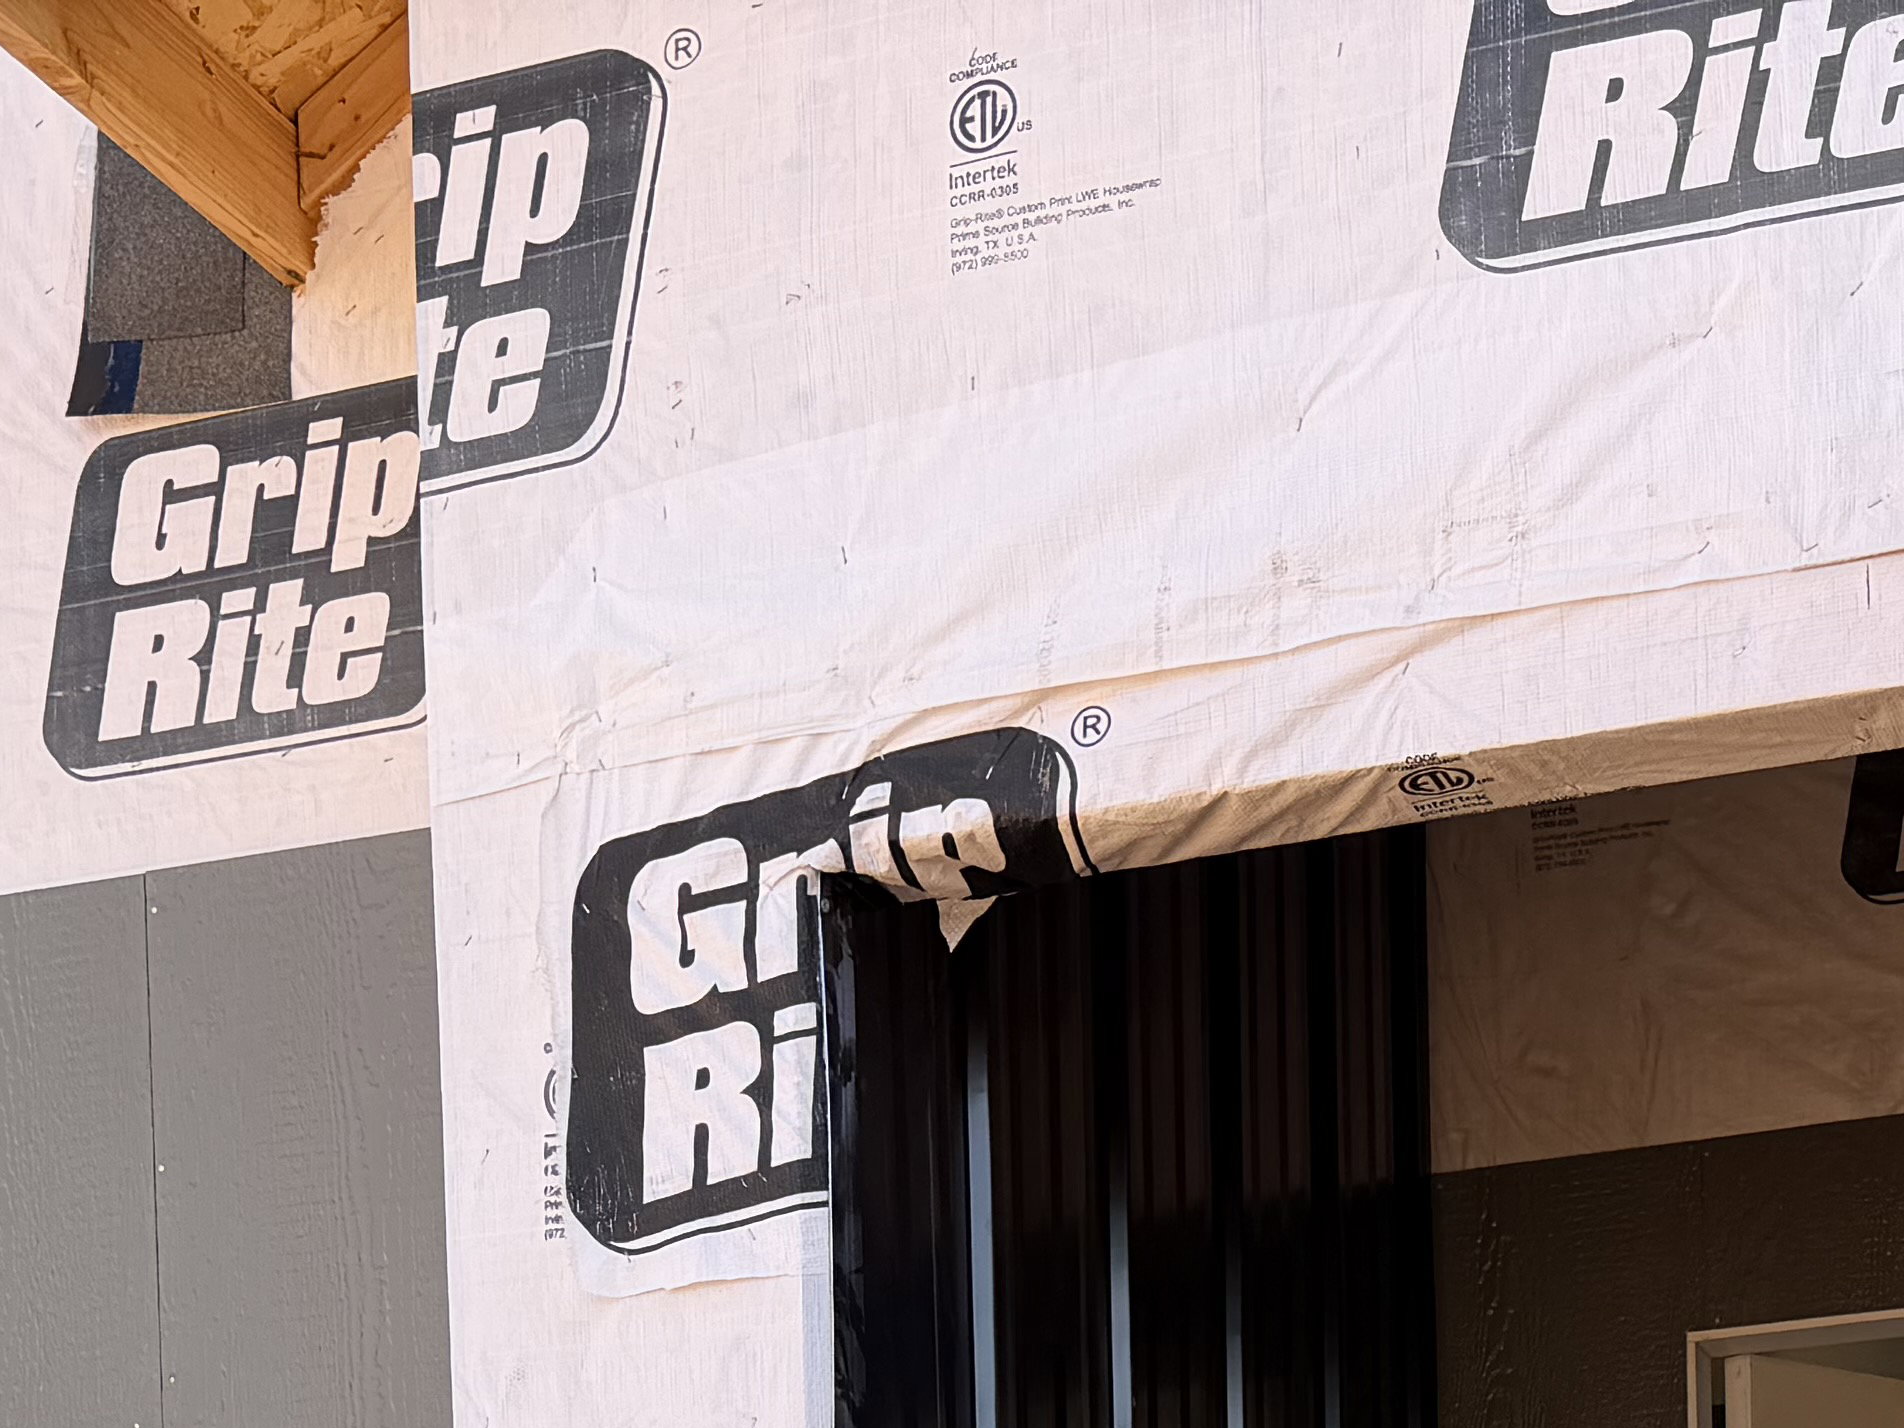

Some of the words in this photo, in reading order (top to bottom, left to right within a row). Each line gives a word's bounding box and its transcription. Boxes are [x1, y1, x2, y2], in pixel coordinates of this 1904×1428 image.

[949, 59, 1017, 83] COMPLIANCE
[969, 52, 998, 67] CODE
[949, 160, 1018, 190] Intertek
[950, 183, 1019, 207] CCRR-0305
[1007, 202, 1046, 218] Custom
[950, 229, 980, 244] Prime
[984, 222, 1019, 237] Source
[1022, 212, 1062, 229] Building
[951, 255, 978, 275] (972)
[110, 416, 421, 587] Grip
[97, 578, 390, 742] Rite
[1413, 793, 1488, 813] Intertek
[627, 781, 1006, 1015] Grip
